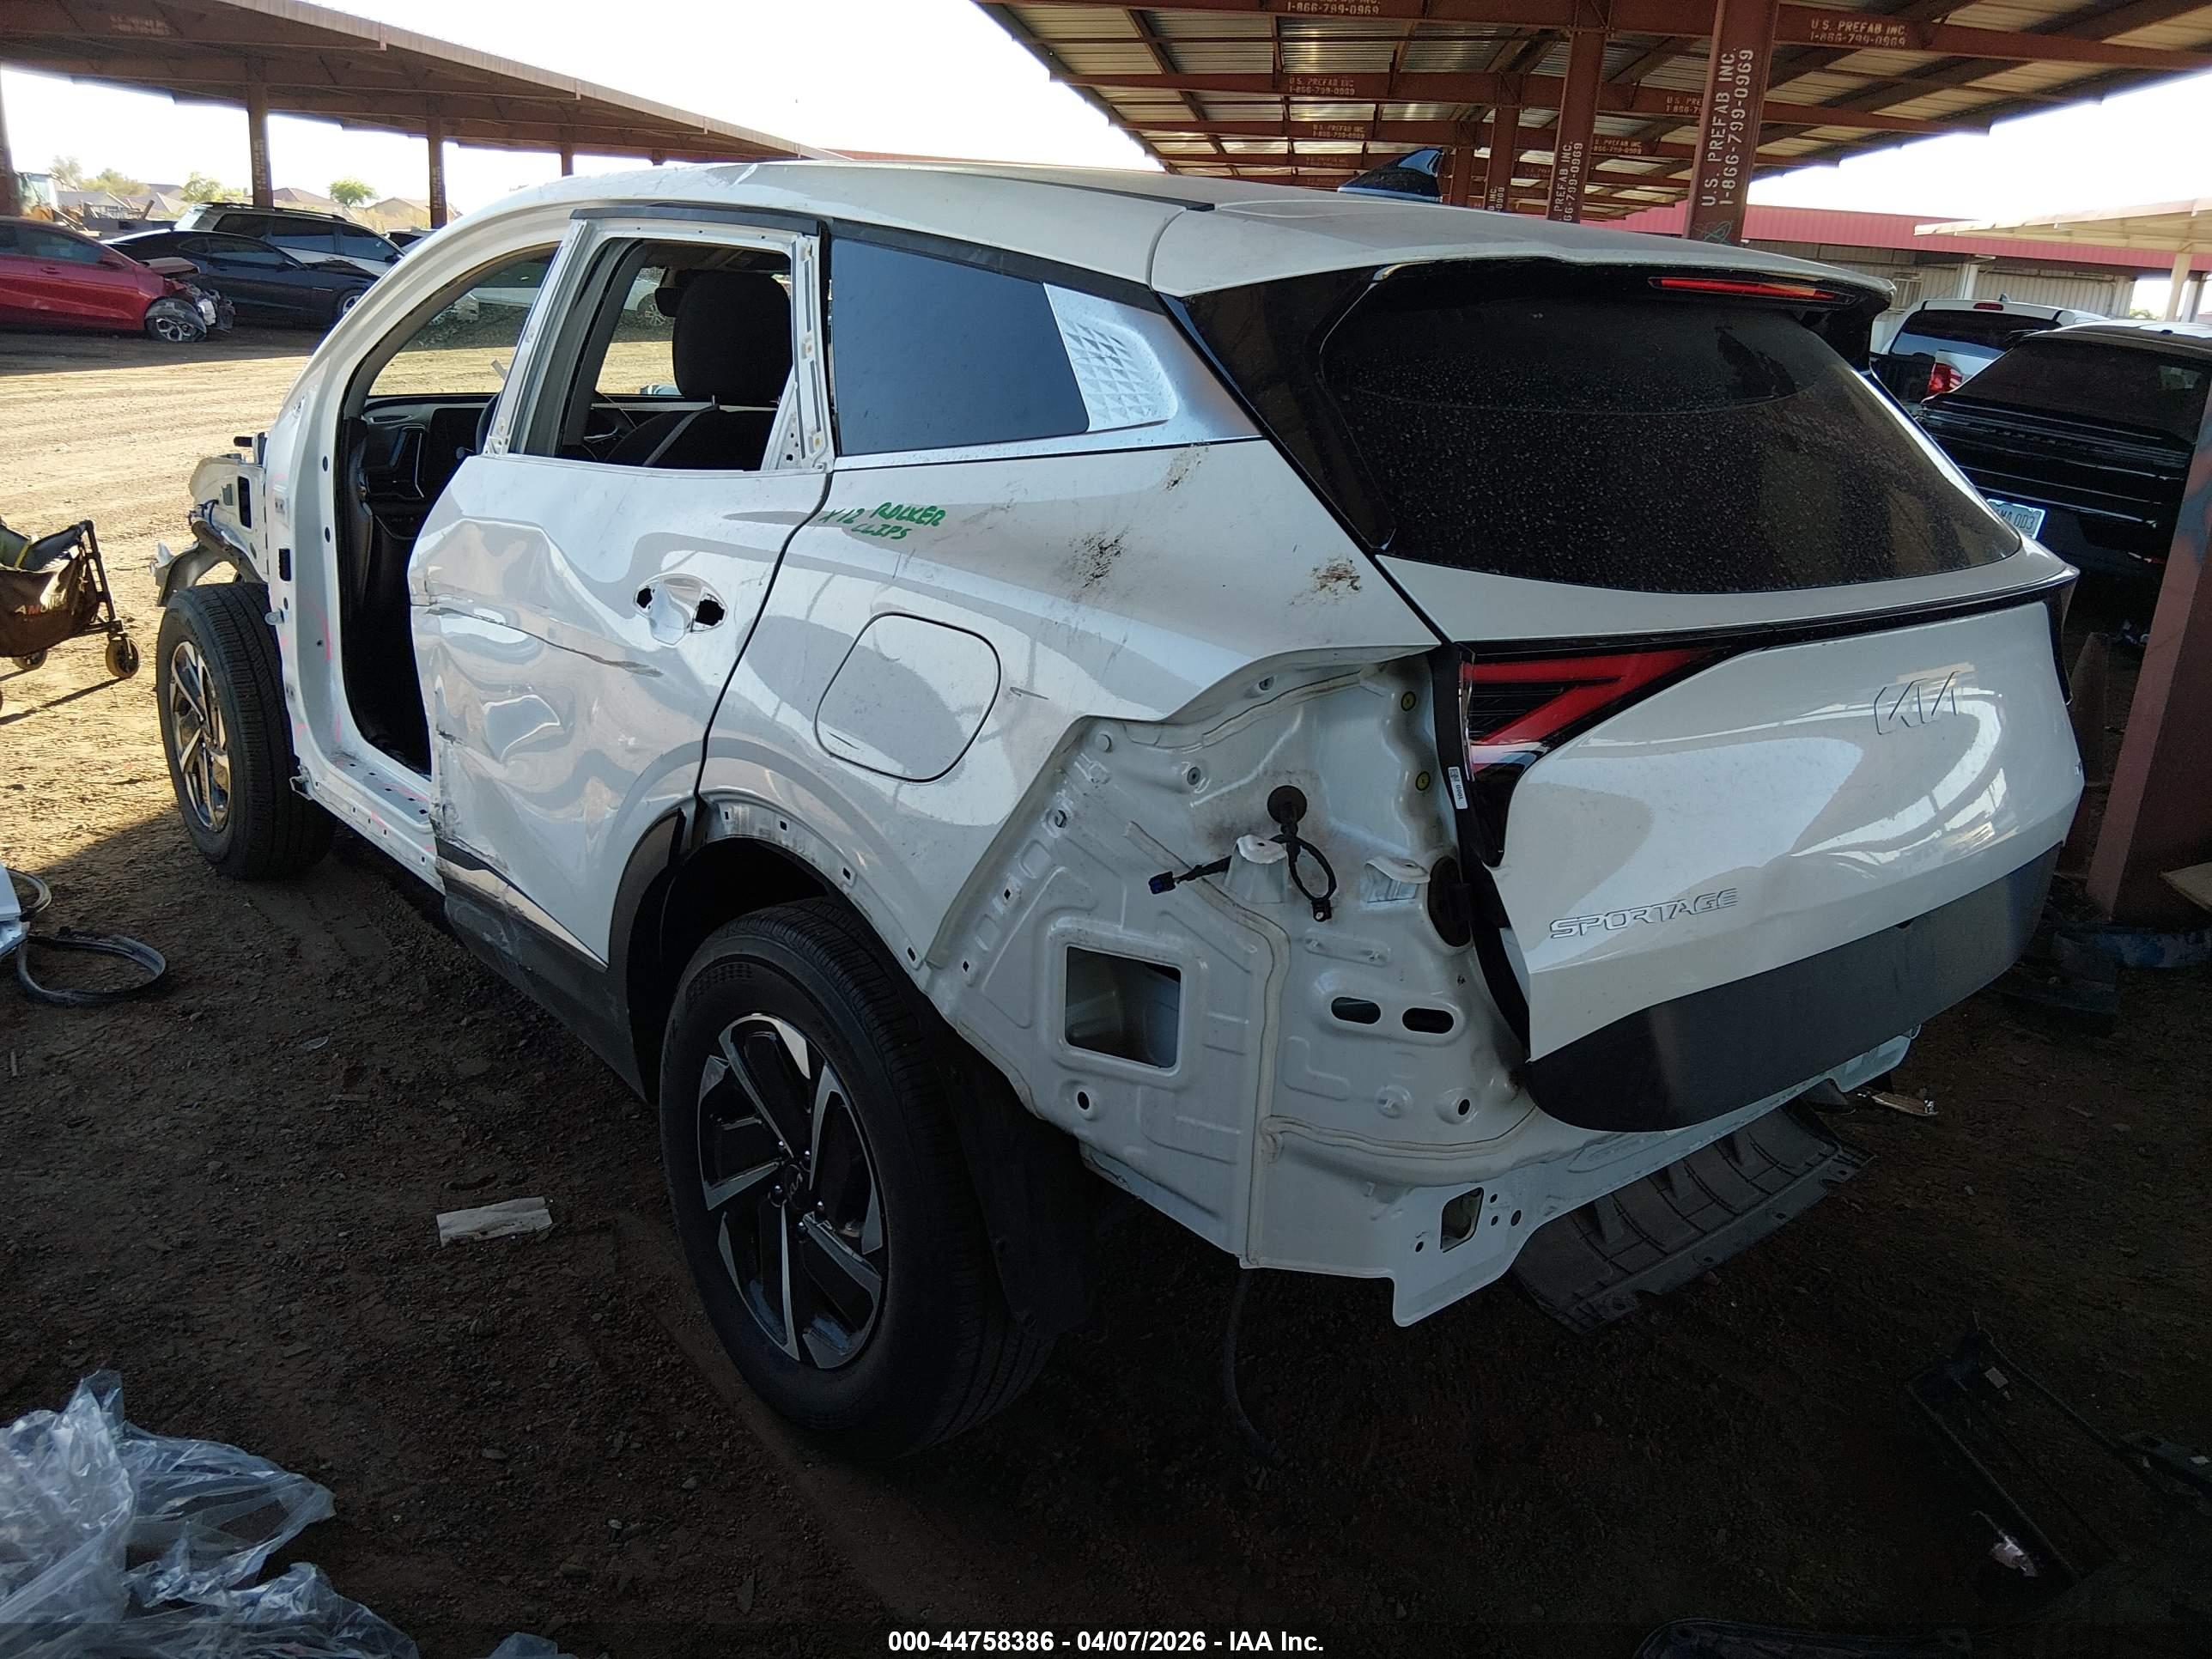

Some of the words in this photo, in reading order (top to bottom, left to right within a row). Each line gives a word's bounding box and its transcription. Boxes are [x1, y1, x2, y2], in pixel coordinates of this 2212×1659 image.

[1838, 21, 1882, 34] PREFAB
[1718, 47, 1737, 82] INC.
[1707, 91, 1730, 162] PREFAB
[1718, 49, 1754, 205] 1-866-799-0969
[1553, 168, 1569, 212] PREFAB
[1561, 141, 1573, 163] INC.
[1563, 143, 1583, 222] 66-799-0969
[1701, 172, 1721, 207] U.S.
[851, 523, 913, 540] CLIPS
[869, 501, 946, 526] ROCKER
[1549, 888, 1739, 939] SPORTAGE
